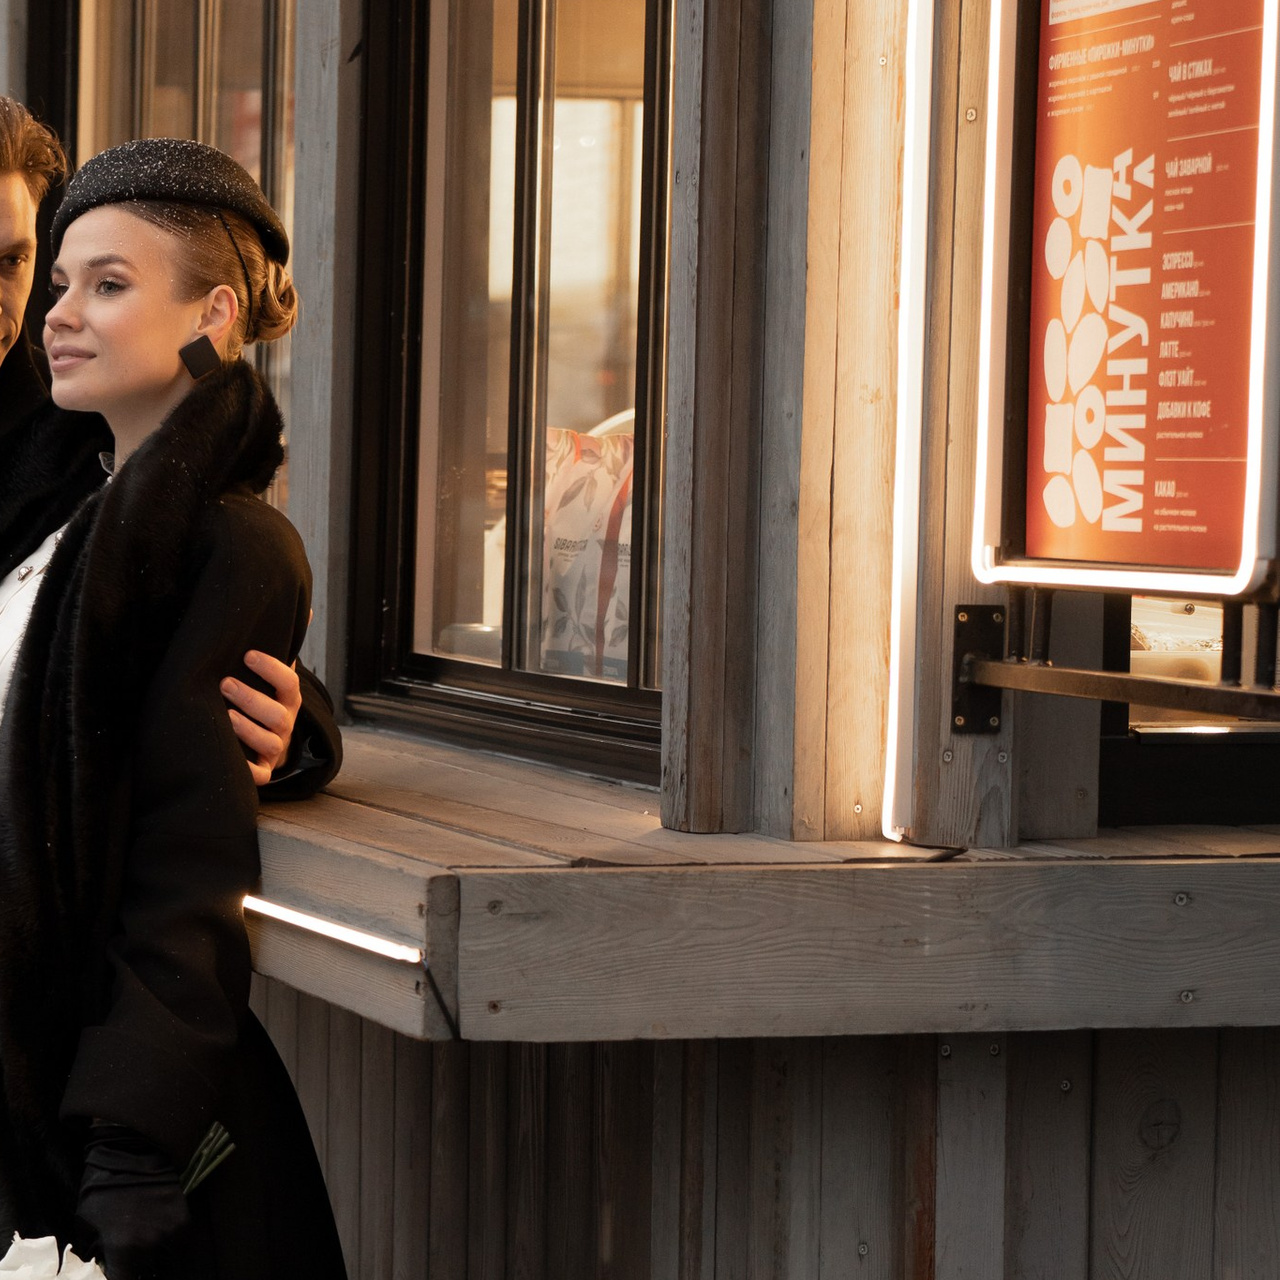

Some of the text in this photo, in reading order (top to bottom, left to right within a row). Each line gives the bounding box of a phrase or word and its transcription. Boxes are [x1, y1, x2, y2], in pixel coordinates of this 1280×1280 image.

[1049, 47, 1087, 70] ФИРМЕННЫЕ
[1169, 62, 1182, 83] ЧАЙ
[1182, 63, 1187, 80] В
[1187, 59, 1212, 79] СТИКАХ
[1165, 153, 1212, 178] ЧАЙ ЗАВАРНОЙ
[1162, 251, 1193, 270] ЭСПРЕССО
[1161, 280, 1199, 299] АМЕРИКАНО
[1160, 311, 1194, 329] КАПУЧИНО
[1102, 148, 1155, 533] МИНУТКА
[1159, 341, 1179, 358] ЛАТТЕ
[1158, 366, 1194, 387] ФЛЭТ УАЙТ
[1157, 401, 1211, 420] ДОБАВКИ К КОФЕ
[1155, 481, 1175, 497] КАКАО
